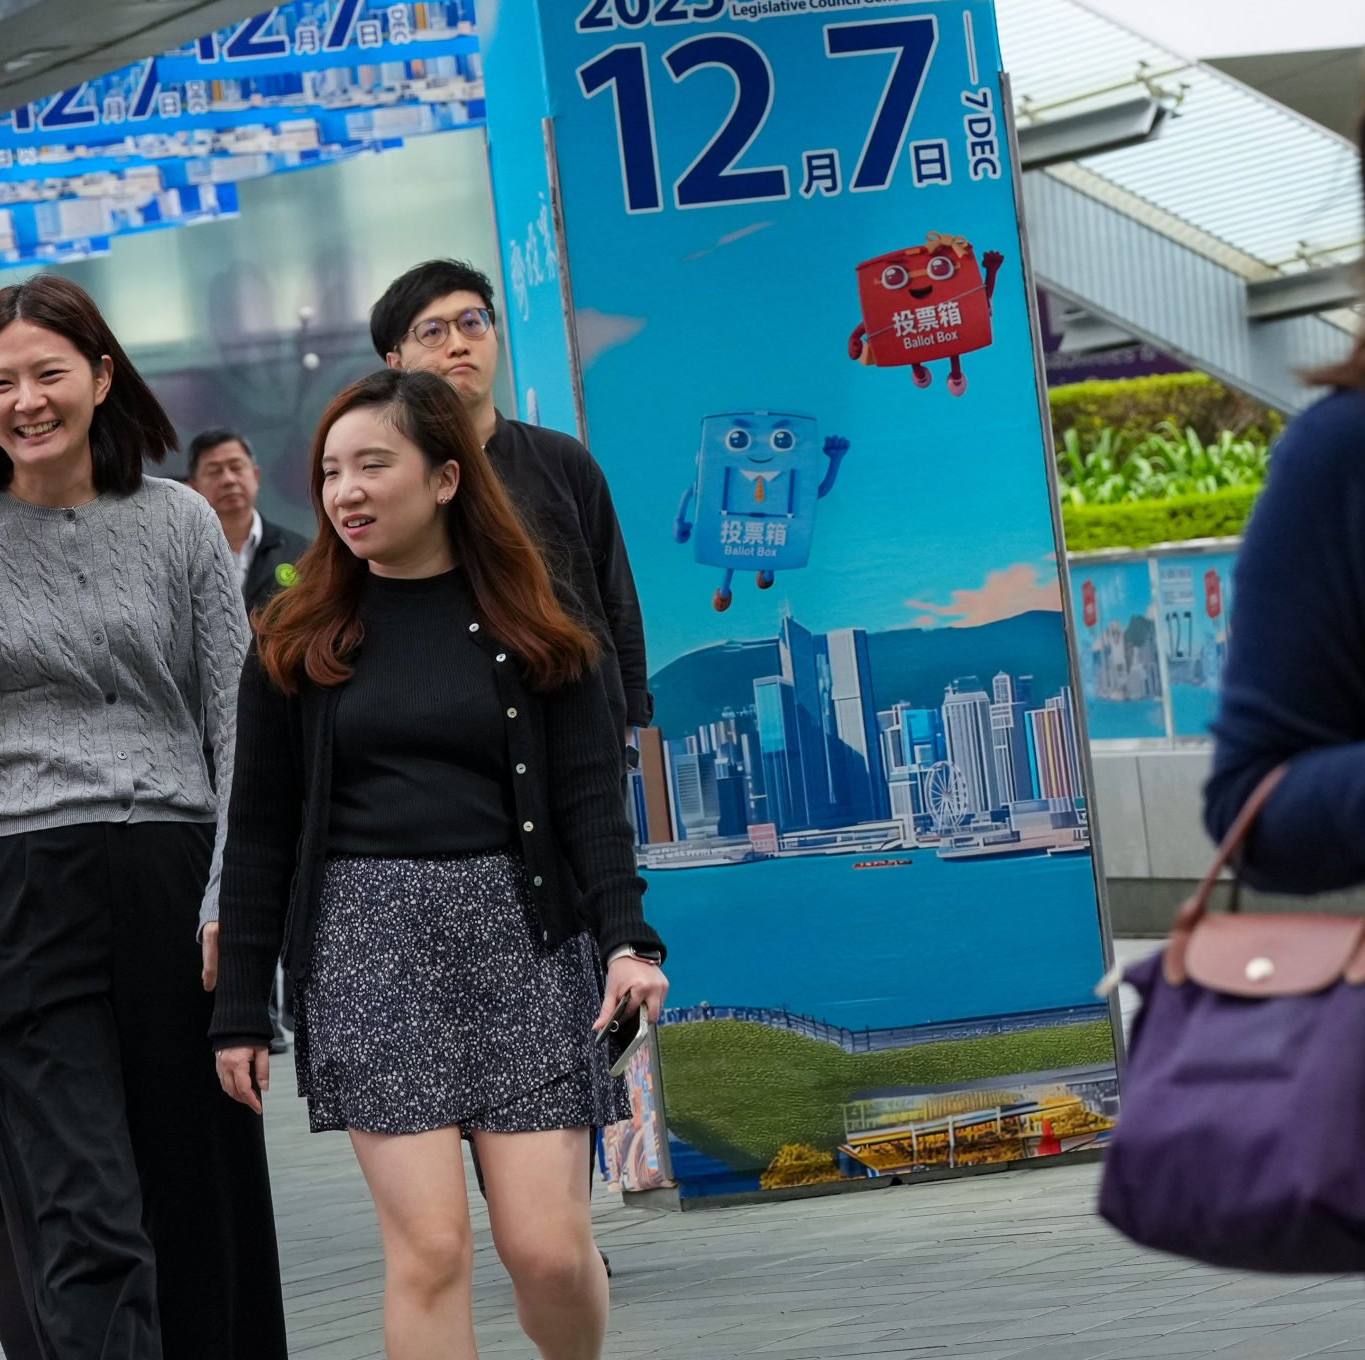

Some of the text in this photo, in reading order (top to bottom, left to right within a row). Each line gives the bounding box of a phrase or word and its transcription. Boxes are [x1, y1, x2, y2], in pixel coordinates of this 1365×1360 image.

[579, 18, 947, 211] 12月7日
[892, 301, 962, 339] 投票箱
[903, 329, 959, 349] Ballot Box
[721, 521, 787, 548] 投票箱
[724, 544, 778, 558] Ballot Box
